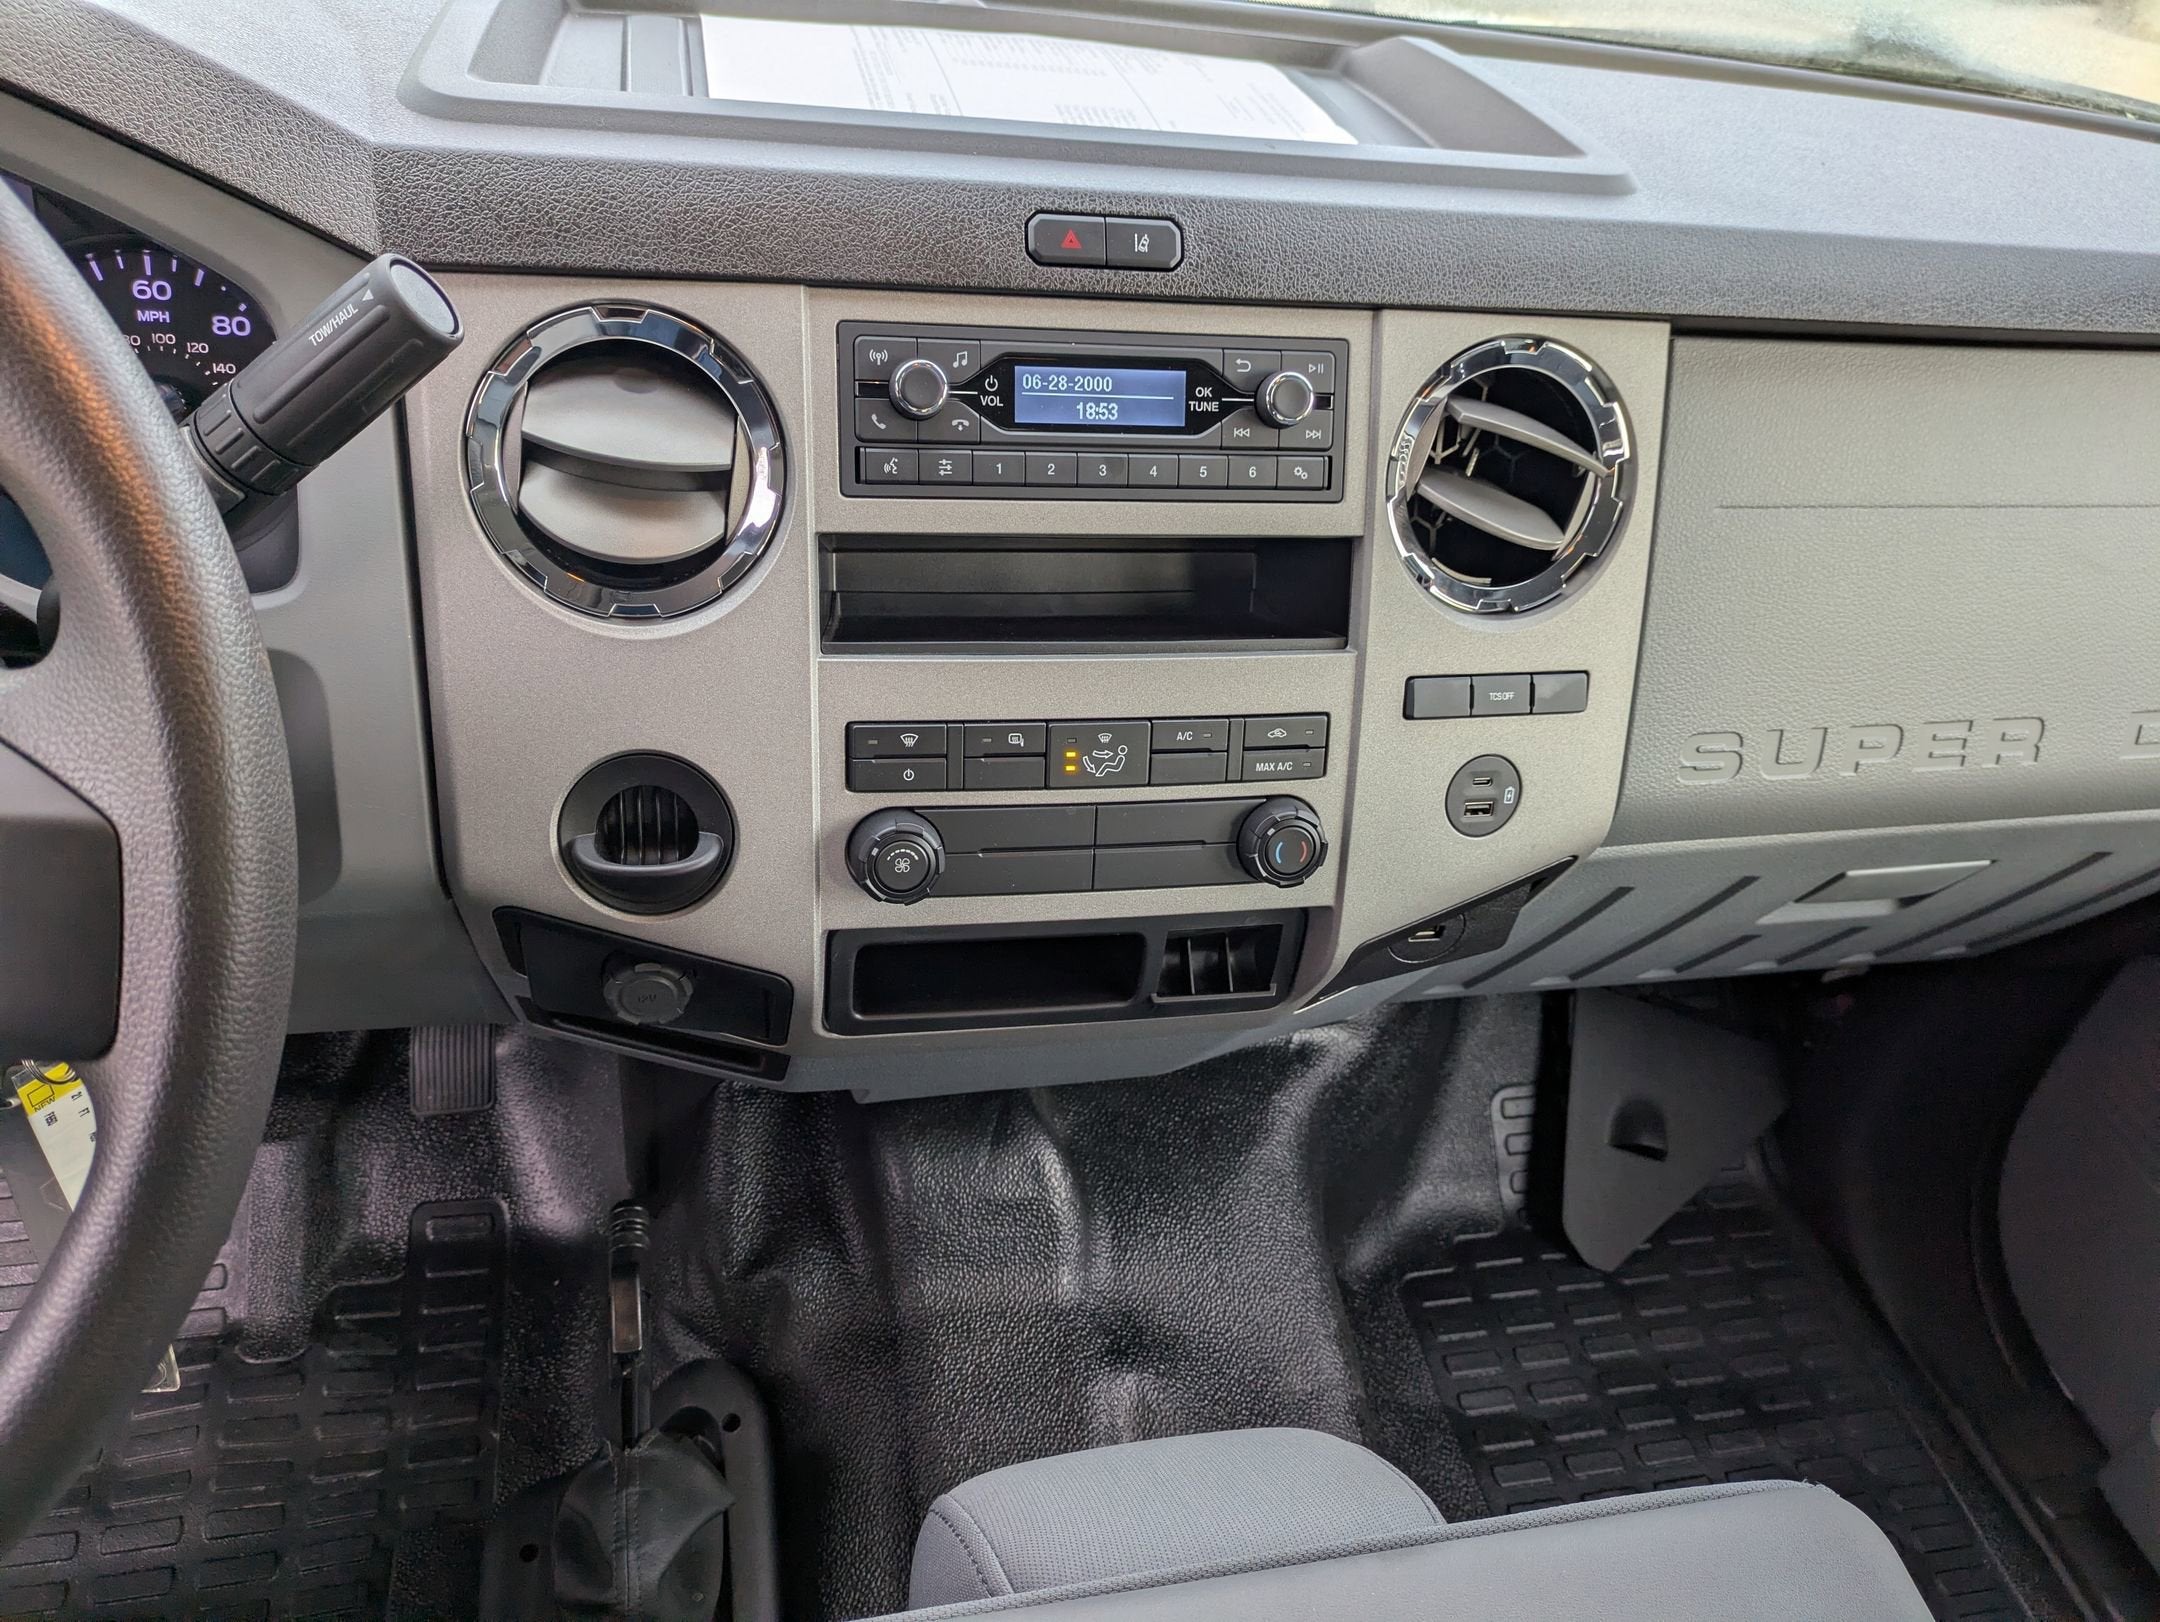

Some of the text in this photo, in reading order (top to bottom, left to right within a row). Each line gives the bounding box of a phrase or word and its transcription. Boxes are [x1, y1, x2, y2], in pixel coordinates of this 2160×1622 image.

[132, 280, 172, 300] 60
[137, 310, 170, 322] MPH
[212, 316, 251, 336] 80
[308, 303, 359, 346] TOW/HAUL
[151, 333, 176, 344] 100
[187, 342, 209, 353] 120
[212, 363, 236, 374] 140
[1022, 374, 1112, 391] 06-28-2000
[1195, 387, 1212, 398] OK
[980, 396, 1003, 406] VOL
[1189, 401, 1219, 412] TUNE
[1076, 403, 1118, 420] 18:53
[996, 463, 1002, 475] 1
[1047, 464, 1055, 475] 2
[1099, 464, 1107, 476] 3
[1149, 465, 1157, 477] 4
[1199, 466, 1207, 478] 5
[1249, 467, 1257, 478] 6
[1488, 691, 1515, 701] TCS OFF
[1176, 731, 1193, 741] A/C
[1677, 715, 2046, 785] SUPER
[1255, 761, 1293, 772] MAX A/C
